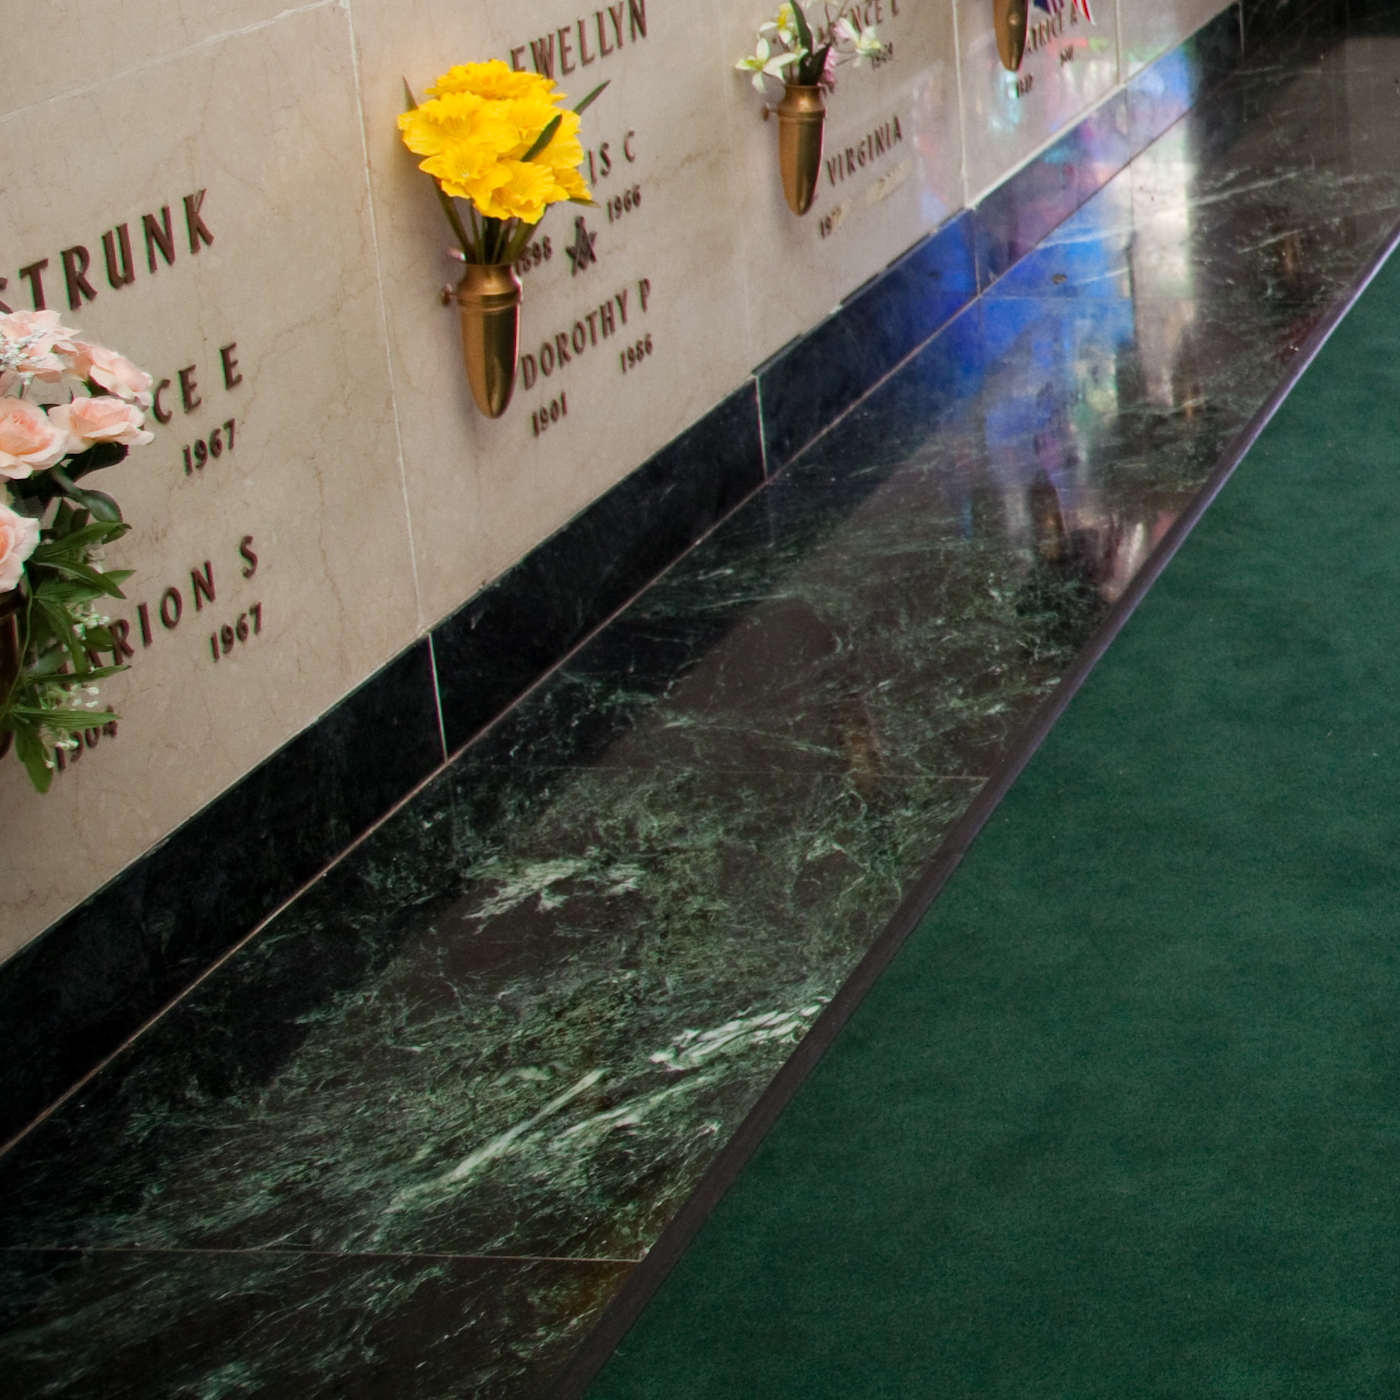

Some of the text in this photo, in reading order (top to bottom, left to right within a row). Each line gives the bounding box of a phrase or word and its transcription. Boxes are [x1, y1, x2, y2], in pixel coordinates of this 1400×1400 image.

[826, 115, 903, 186] VIRGINIA
[606, 185, 642, 224] 1966
[521, 278, 651, 392] DOROTHY P
[531, 391, 568, 438] 1901
[182, 418, 237, 476] 1967
[209, 602, 262, 663] 1967
